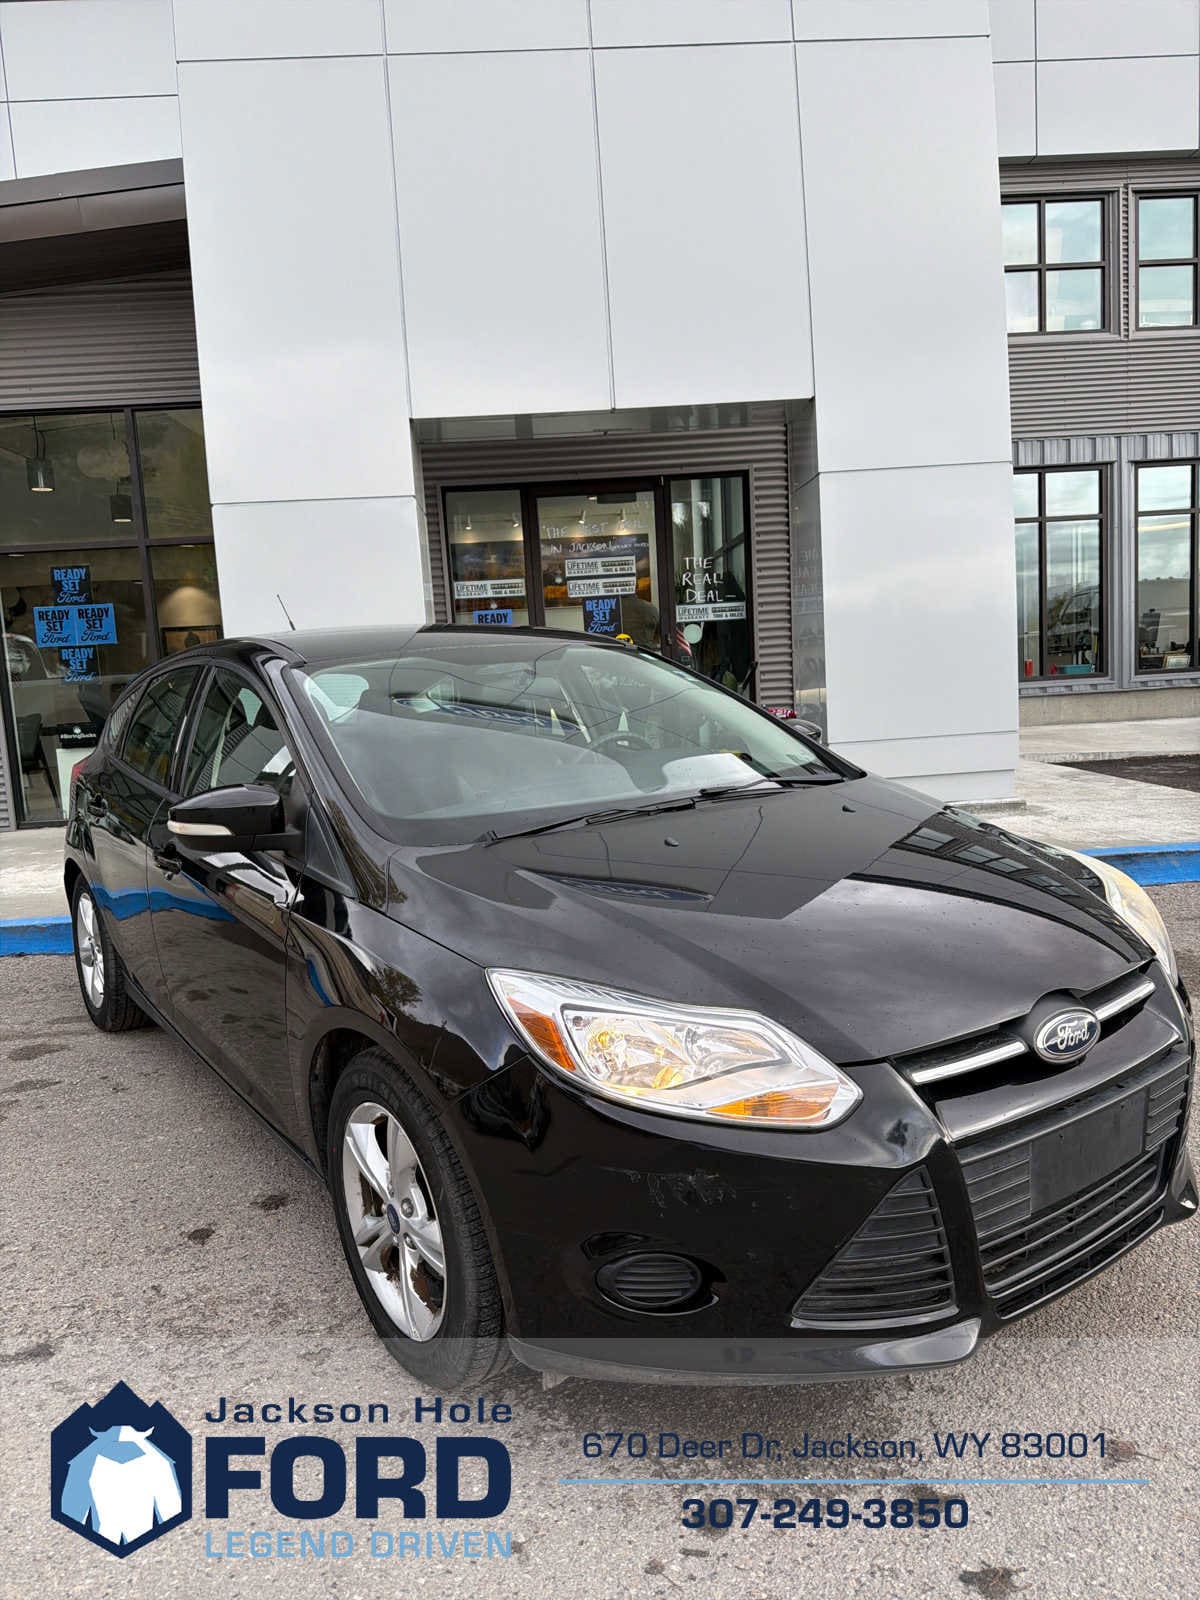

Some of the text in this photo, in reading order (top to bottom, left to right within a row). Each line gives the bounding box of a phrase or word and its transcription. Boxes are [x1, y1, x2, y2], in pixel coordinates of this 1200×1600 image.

[683, 556, 714, 570] THE
[53, 568, 86, 581] READY
[682, 571, 724, 586] REAL
[61, 581, 80, 592] SET
[56, 592, 88, 603] Ford
[585, 598, 617, 611] READY
[38, 609, 70, 622] READY
[77, 607, 110, 620] READY
[477, 612, 509, 624] READY
[593, 610, 610, 621] SET
[46, 620, 64, 632] SET
[85, 618, 104, 630] SET
[588, 623, 618, 633] Ford
[41, 632, 71, 644] Ford
[80, 630, 110, 642] Ford
[61, 648, 94, 661] READY
[69, 659, 87, 671] SET
[65, 671, 95, 683] Ford
[1056, 1020, 1091, 1050] Ford
